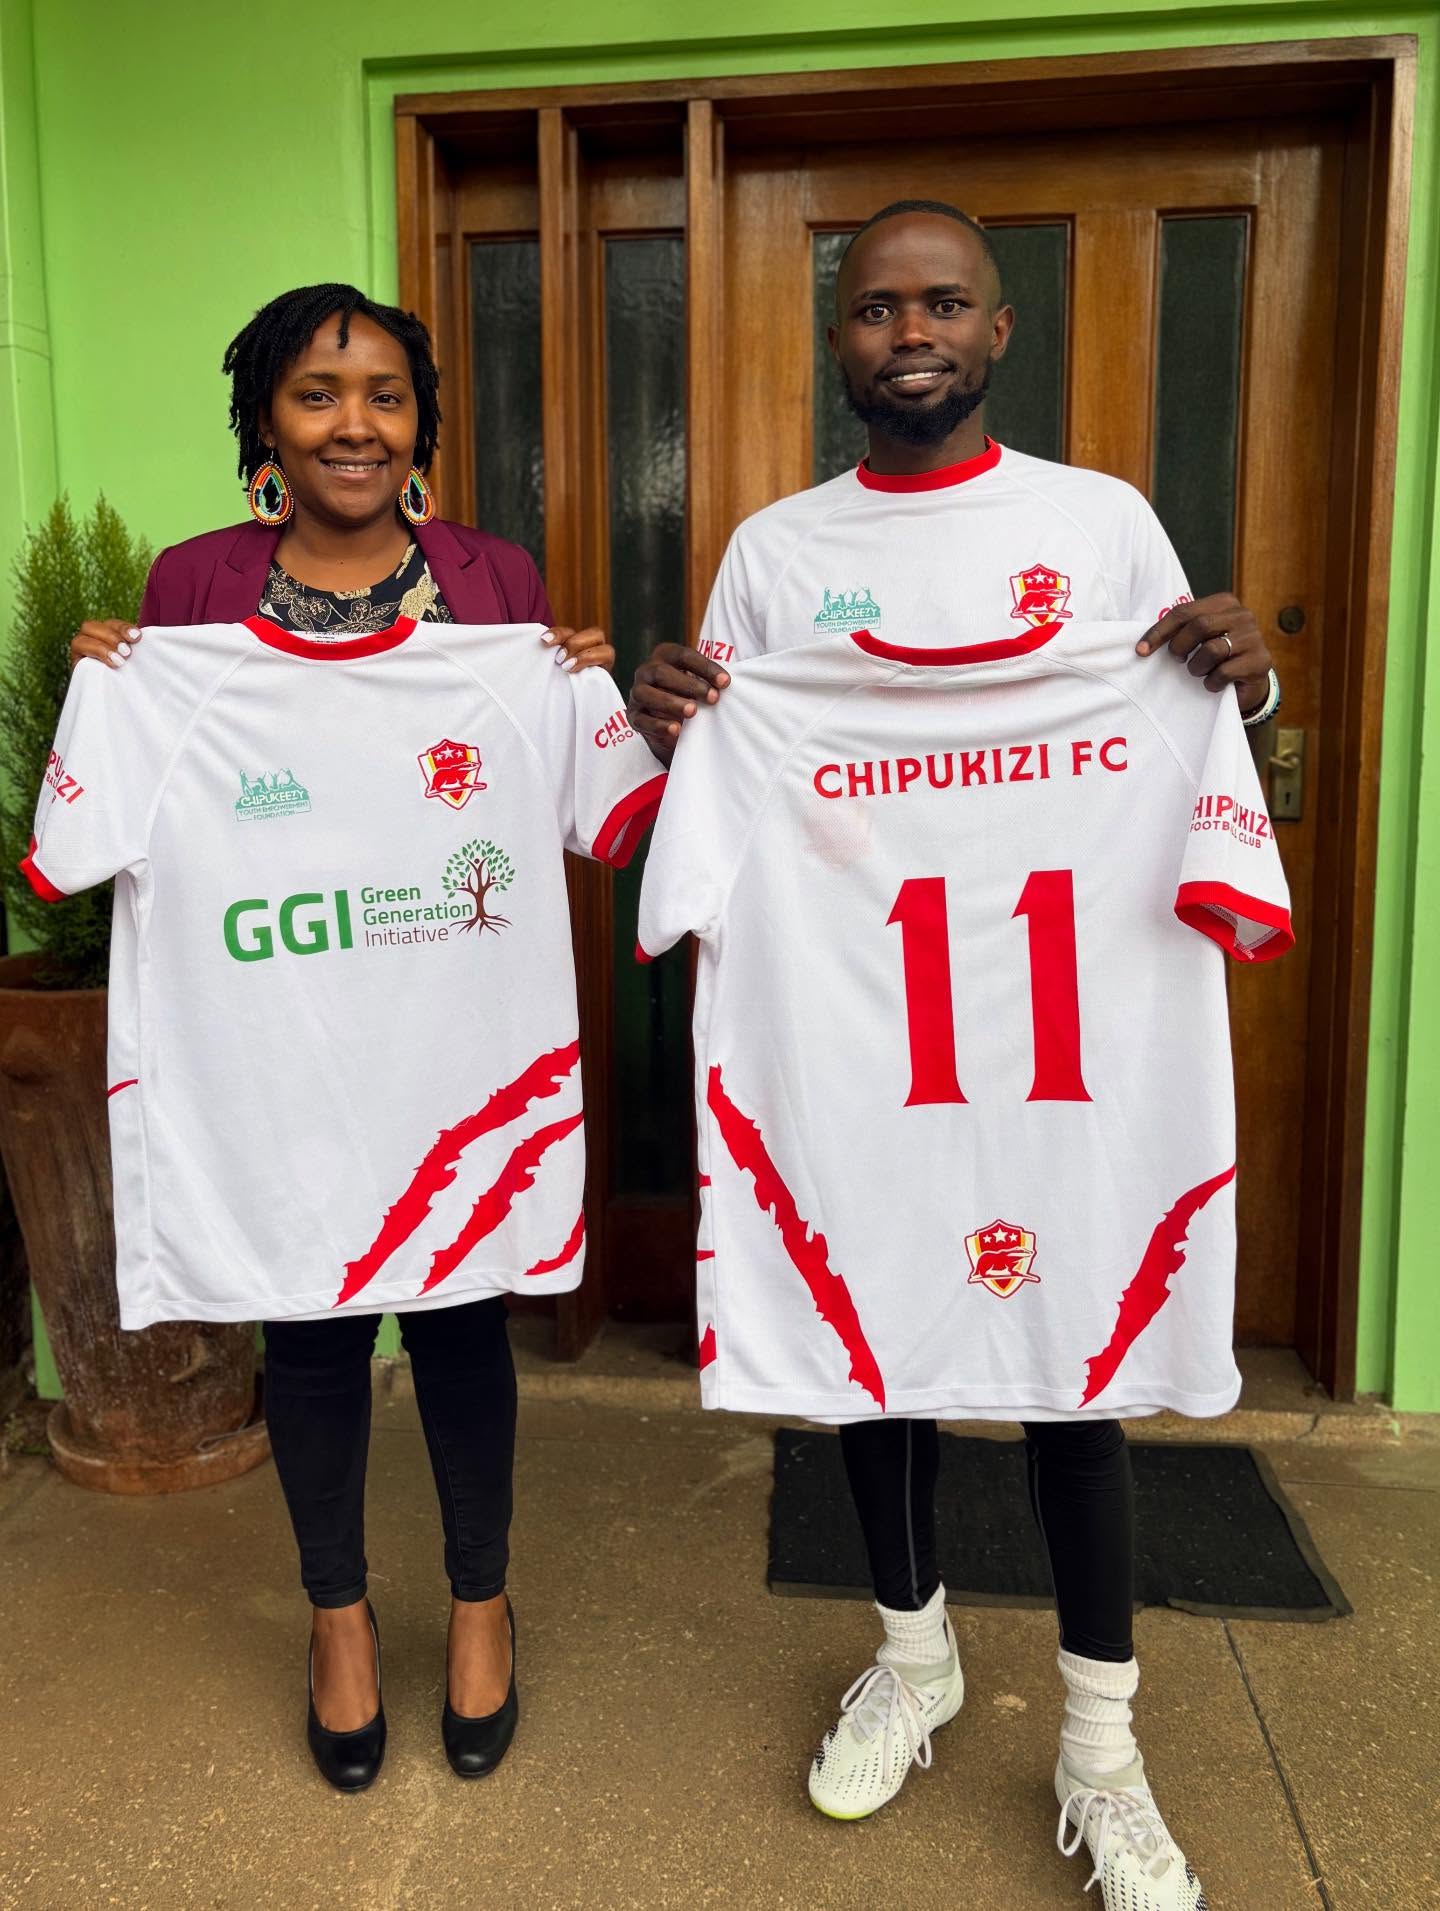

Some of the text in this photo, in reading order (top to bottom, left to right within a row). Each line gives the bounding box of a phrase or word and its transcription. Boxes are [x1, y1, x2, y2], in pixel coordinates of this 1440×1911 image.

[820, 607, 877, 620] CHIPUKEEZY
[594, 708, 628, 749] CHI
[611, 729, 634, 748] FOO
[813, 736, 1128, 799] CHIPUKIZI FC
[240, 789, 304, 807] CHIPUKEEZY
[1238, 832, 1262, 849] CLUB
[223, 886, 422, 963] GGI Green
[363, 901, 473, 926] Generation
[364, 925, 449, 948] Initiative
[885, 868, 1095, 1108] 11
